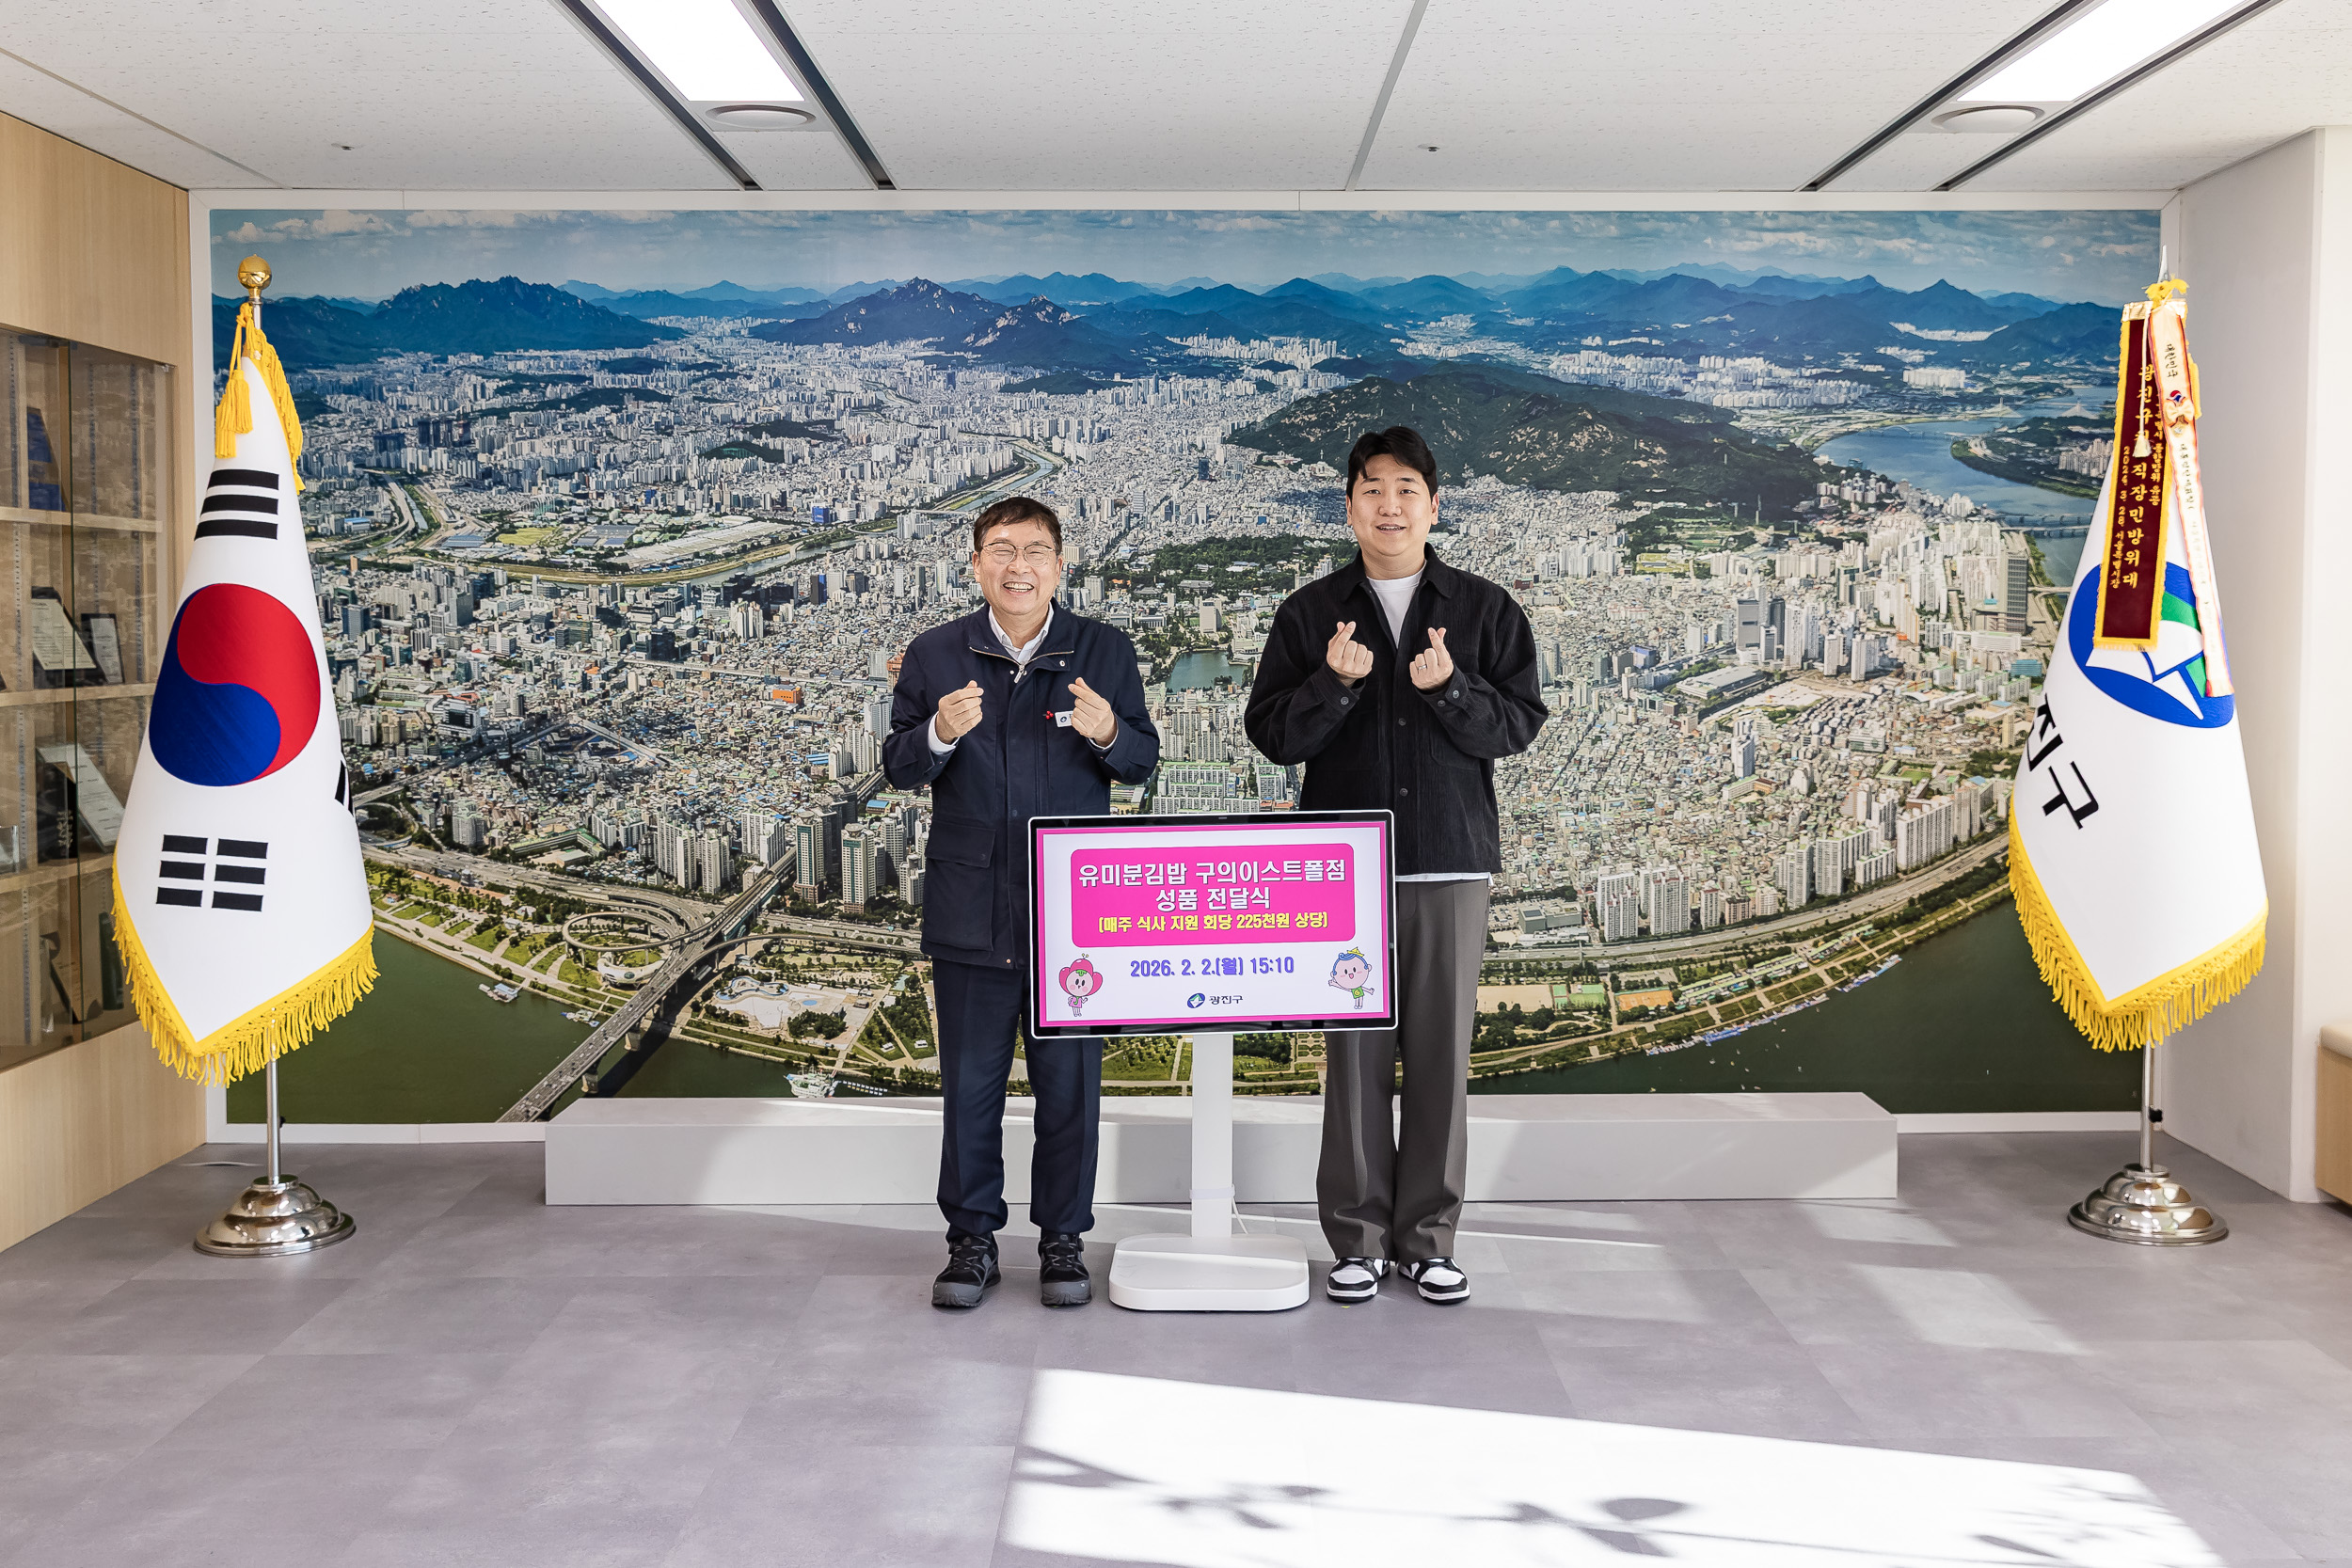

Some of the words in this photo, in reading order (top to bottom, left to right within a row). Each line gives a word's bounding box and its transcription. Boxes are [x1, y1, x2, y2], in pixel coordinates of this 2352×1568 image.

[2149, 485, 2161, 506] 유공
[2122, 462, 2148, 589] 직장민방위대
[2110, 531, 2124, 589] 서울특별시장
[1078, 863, 1187, 887] 유미분김밥
[1195, 859, 1346, 884] 구의이스트폴점
[1155, 889, 1199, 912] 성품
[1206, 886, 1271, 911] 전달식
[1136, 915, 1167, 932] 식사
[1169, 914, 1200, 931] 지원
[1203, 913, 1233, 930] 회당
[1236, 912, 1291, 929] 225천원
[1130, 959, 1175, 977] 2026.
[1181, 958, 1196, 976] 2.
[1249, 956, 1295, 974] 15:10
[1208, 994, 1244, 1006] 광진구
